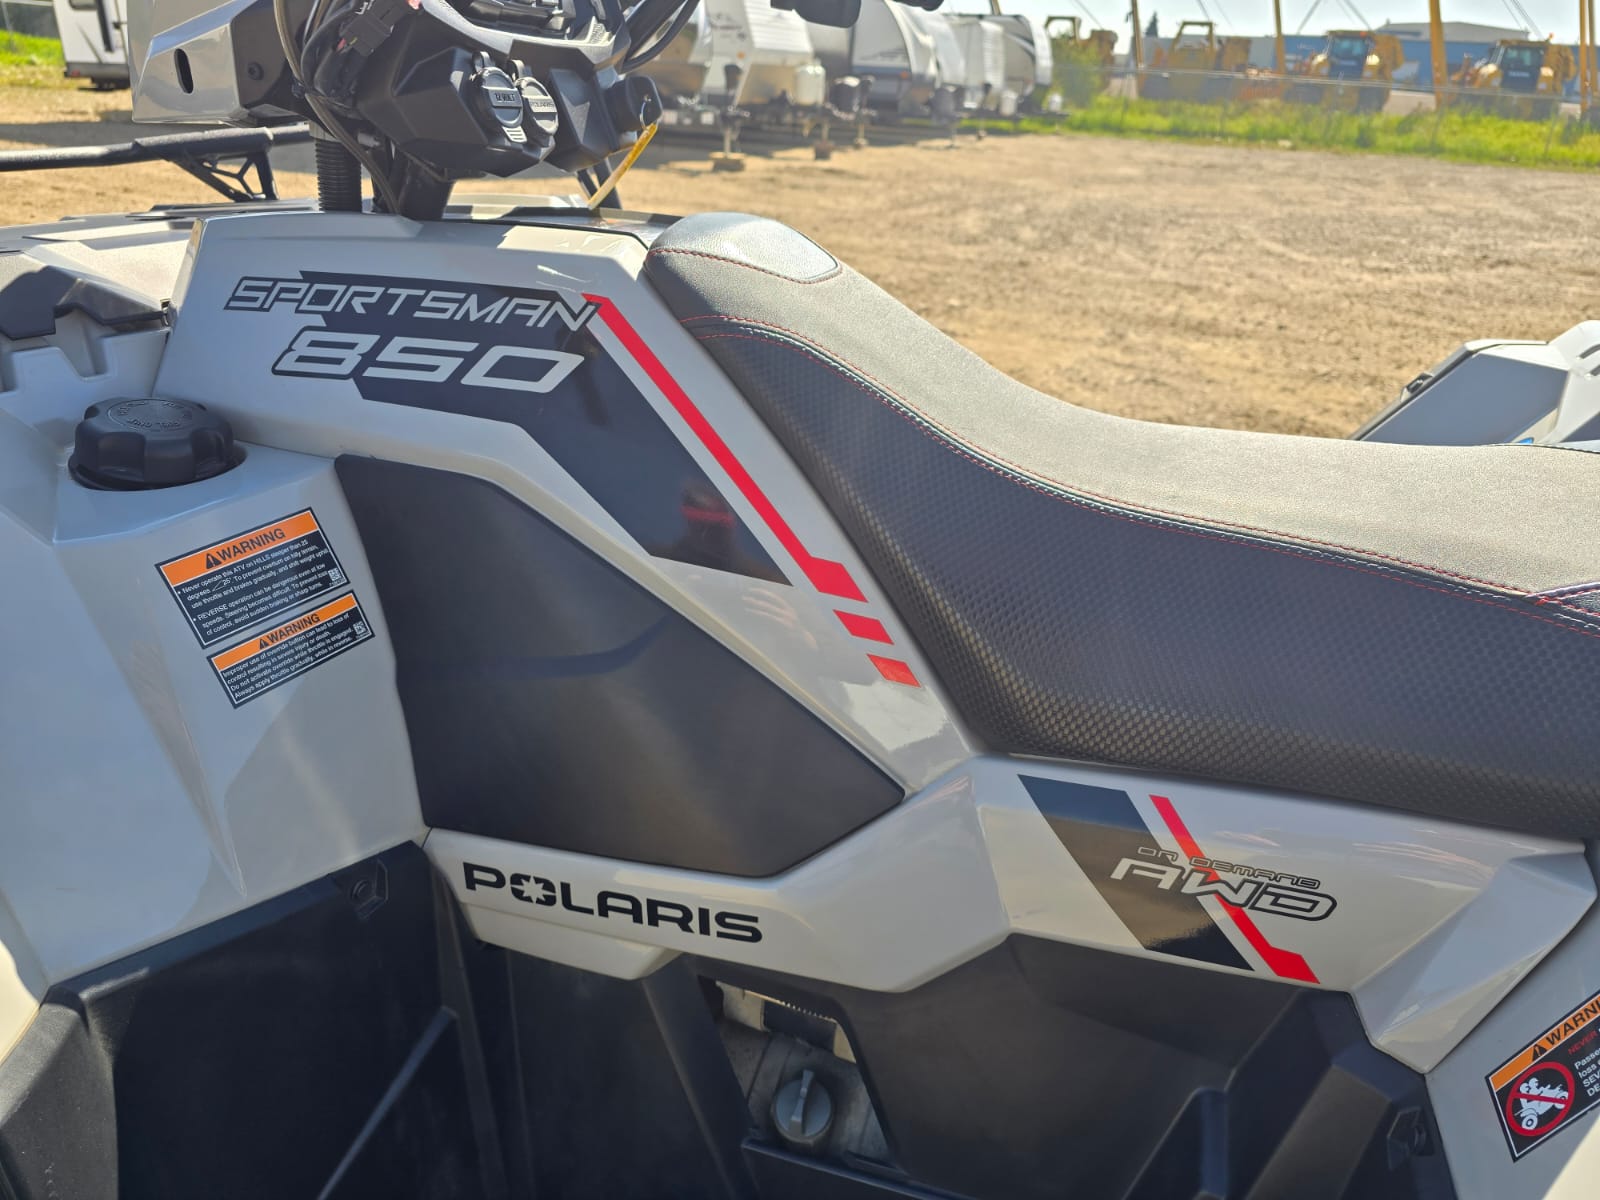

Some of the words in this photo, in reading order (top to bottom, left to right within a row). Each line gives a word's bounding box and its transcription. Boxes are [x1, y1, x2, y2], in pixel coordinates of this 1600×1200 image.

[225, 277, 598, 331] SPORTSMAN
[272, 326, 584, 393] 850
[216, 527, 285, 561] WARNING
[181, 582, 200, 593] Never
[199, 573, 223, 587] operate
[221, 569, 233, 577] this
[232, 564, 246, 573] ATV
[252, 554, 270, 565] HILLS
[289, 542, 301, 550] than
[186, 587, 211, 601] degrees
[241, 566, 263, 579] prevent
[290, 550, 302, 559] hilly
[221, 587, 234, 595] and
[233, 579, 253, 591] brakes
[277, 564, 289, 573] and
[197, 603, 228, 620] REVERSE
[227, 592, 254, 608] operation
[253, 589, 264, 597] can
[271, 574, 299, 590] dangerous
[298, 569, 311, 578] even
[315, 562, 326, 570] low
[233, 613, 249, 623] avoid
[248, 604, 269, 616] sudden
[294, 587, 309, 598] sharp
[247, 594, 272, 608] becomes
[298, 574, 318, 587] prevent
[222, 661, 250, 678] Improper
[248, 657, 260, 665] use
[259, 652, 267, 660] of
[287, 634, 306, 646] button
[305, 629, 316, 637] can
[314, 623, 327, 633] lead
[332, 615, 343, 624] loss
[266, 612, 320, 644] WARNING
[226, 671, 247, 684] control
[246, 659, 272, 675] resulting
[230, 683, 240, 691] Do
[239, 678, 250, 687] not
[249, 667, 271, 682] activate
[271, 656, 293, 671] override
[234, 684, 255, 699] Always
[254, 676, 271, 689] apply
[269, 666, 290, 680] throttle
[313, 647, 328, 658] while
[1137, 847, 1178, 860] ON
[1189, 856, 1320, 889] DEMAND
[463, 862, 762, 943] POLARIS
[1110, 858, 1337, 921] AWD
[1568, 1030, 1598, 1055] NEVER
[1574, 1047, 1600, 1069] Passe
[1578, 1063, 1597, 1079] loss
